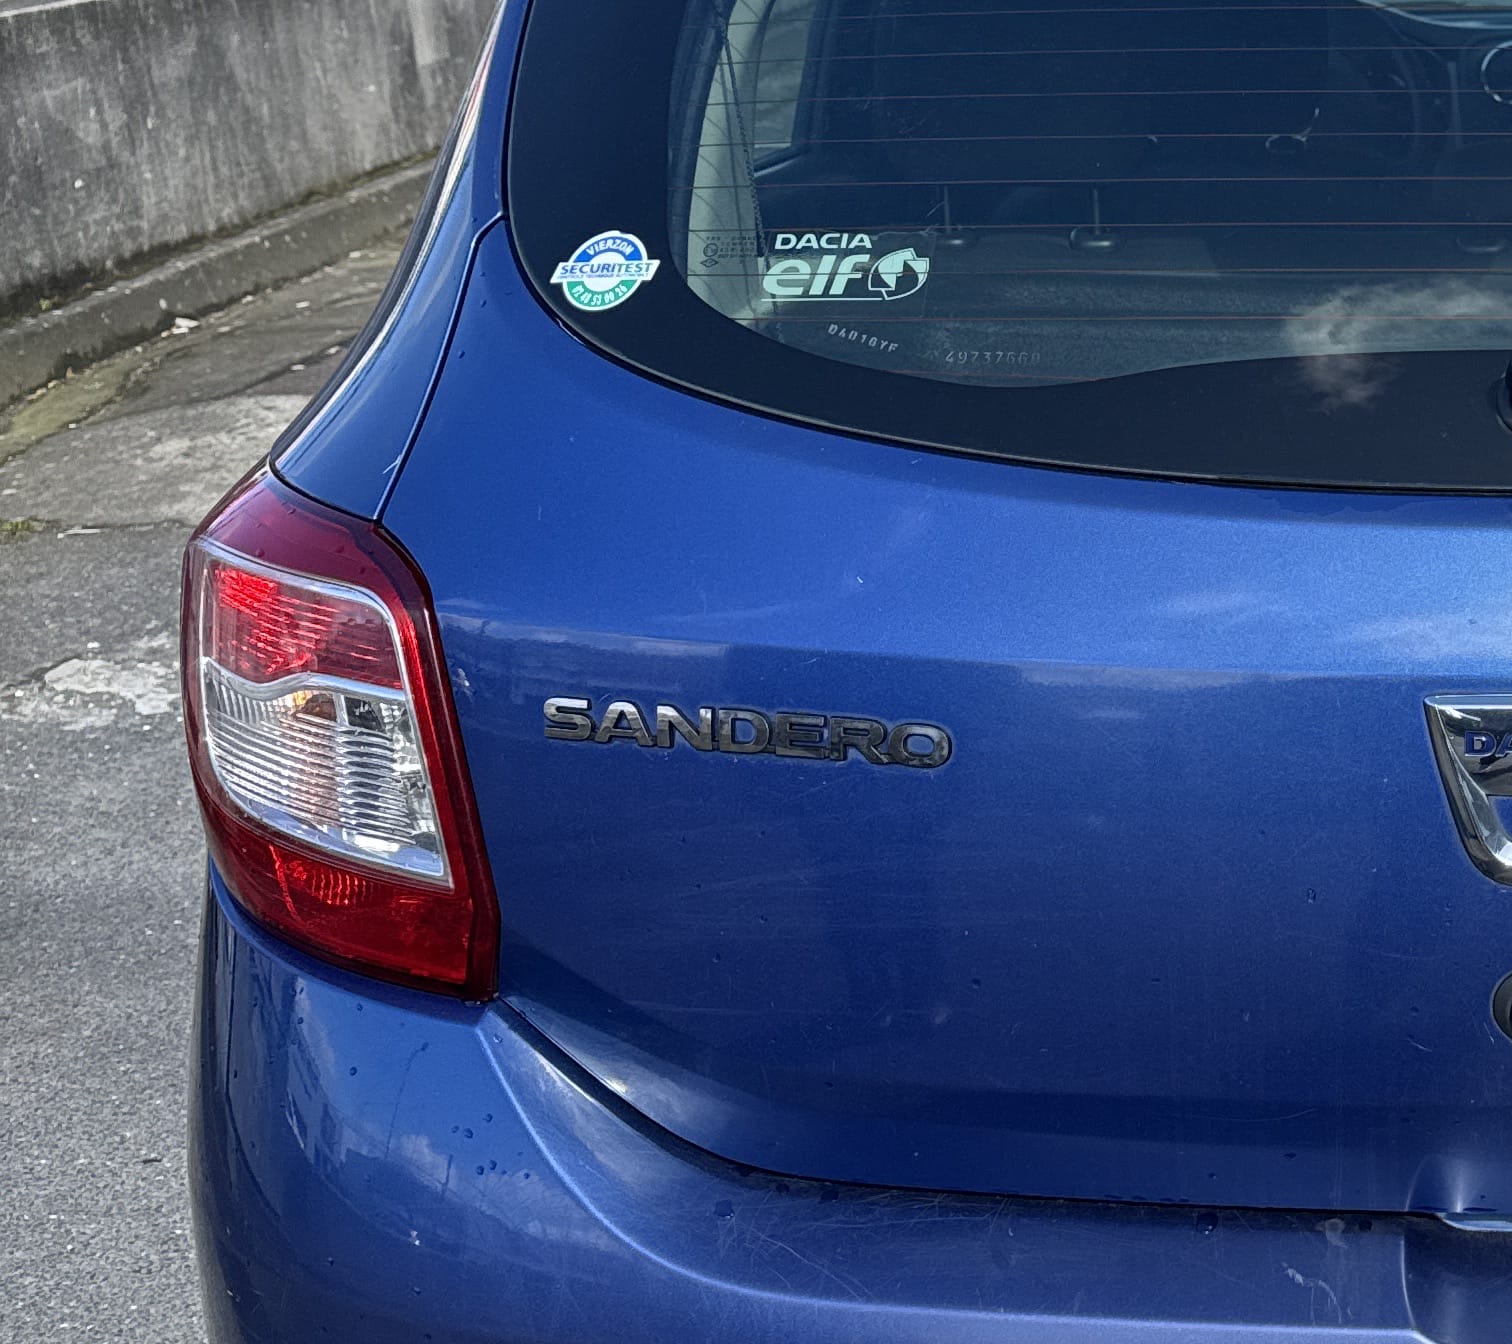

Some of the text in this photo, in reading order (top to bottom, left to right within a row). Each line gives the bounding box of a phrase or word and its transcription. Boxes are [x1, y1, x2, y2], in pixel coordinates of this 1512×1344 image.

[585, 238, 636, 256] VIERZON
[774, 233, 873, 250] DACIA
[560, 263, 654, 275] SECURITEST
[762, 254, 871, 296] elf
[544, 696, 953, 770] SANDERO
